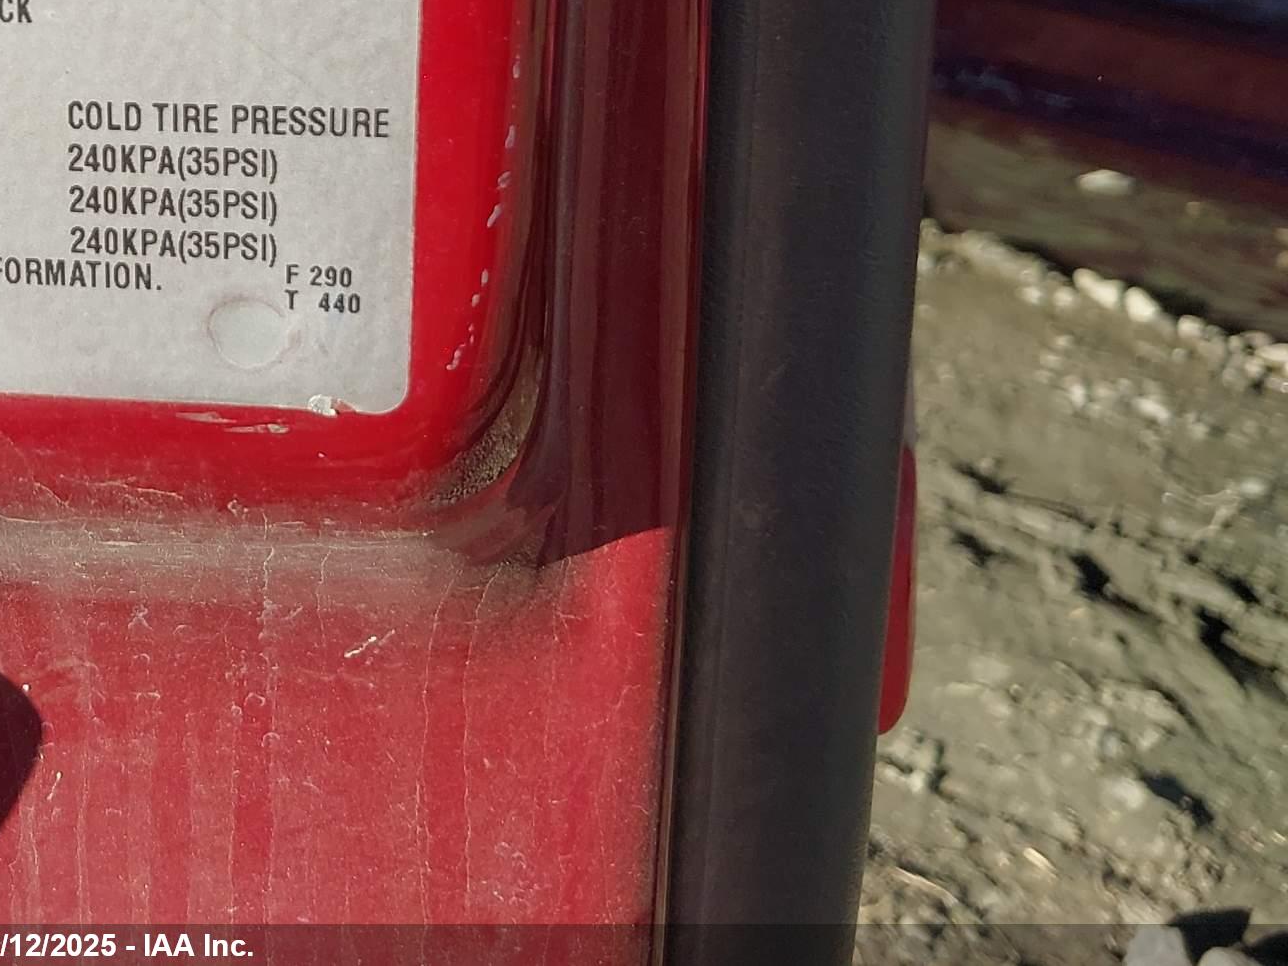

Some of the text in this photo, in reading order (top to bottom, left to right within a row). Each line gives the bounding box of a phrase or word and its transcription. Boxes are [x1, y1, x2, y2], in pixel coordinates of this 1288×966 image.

[69, 101, 389, 138] COLD TIRE PRESSURE
[68, 144, 277, 182] 240KPA(35PSI)
[70, 185, 277, 224] 240KPA(35PSI)
[71, 226, 276, 267] 240KPA(35PSI)
[287, 264, 352, 288] F 290
[285, 290, 360, 313] T 440
